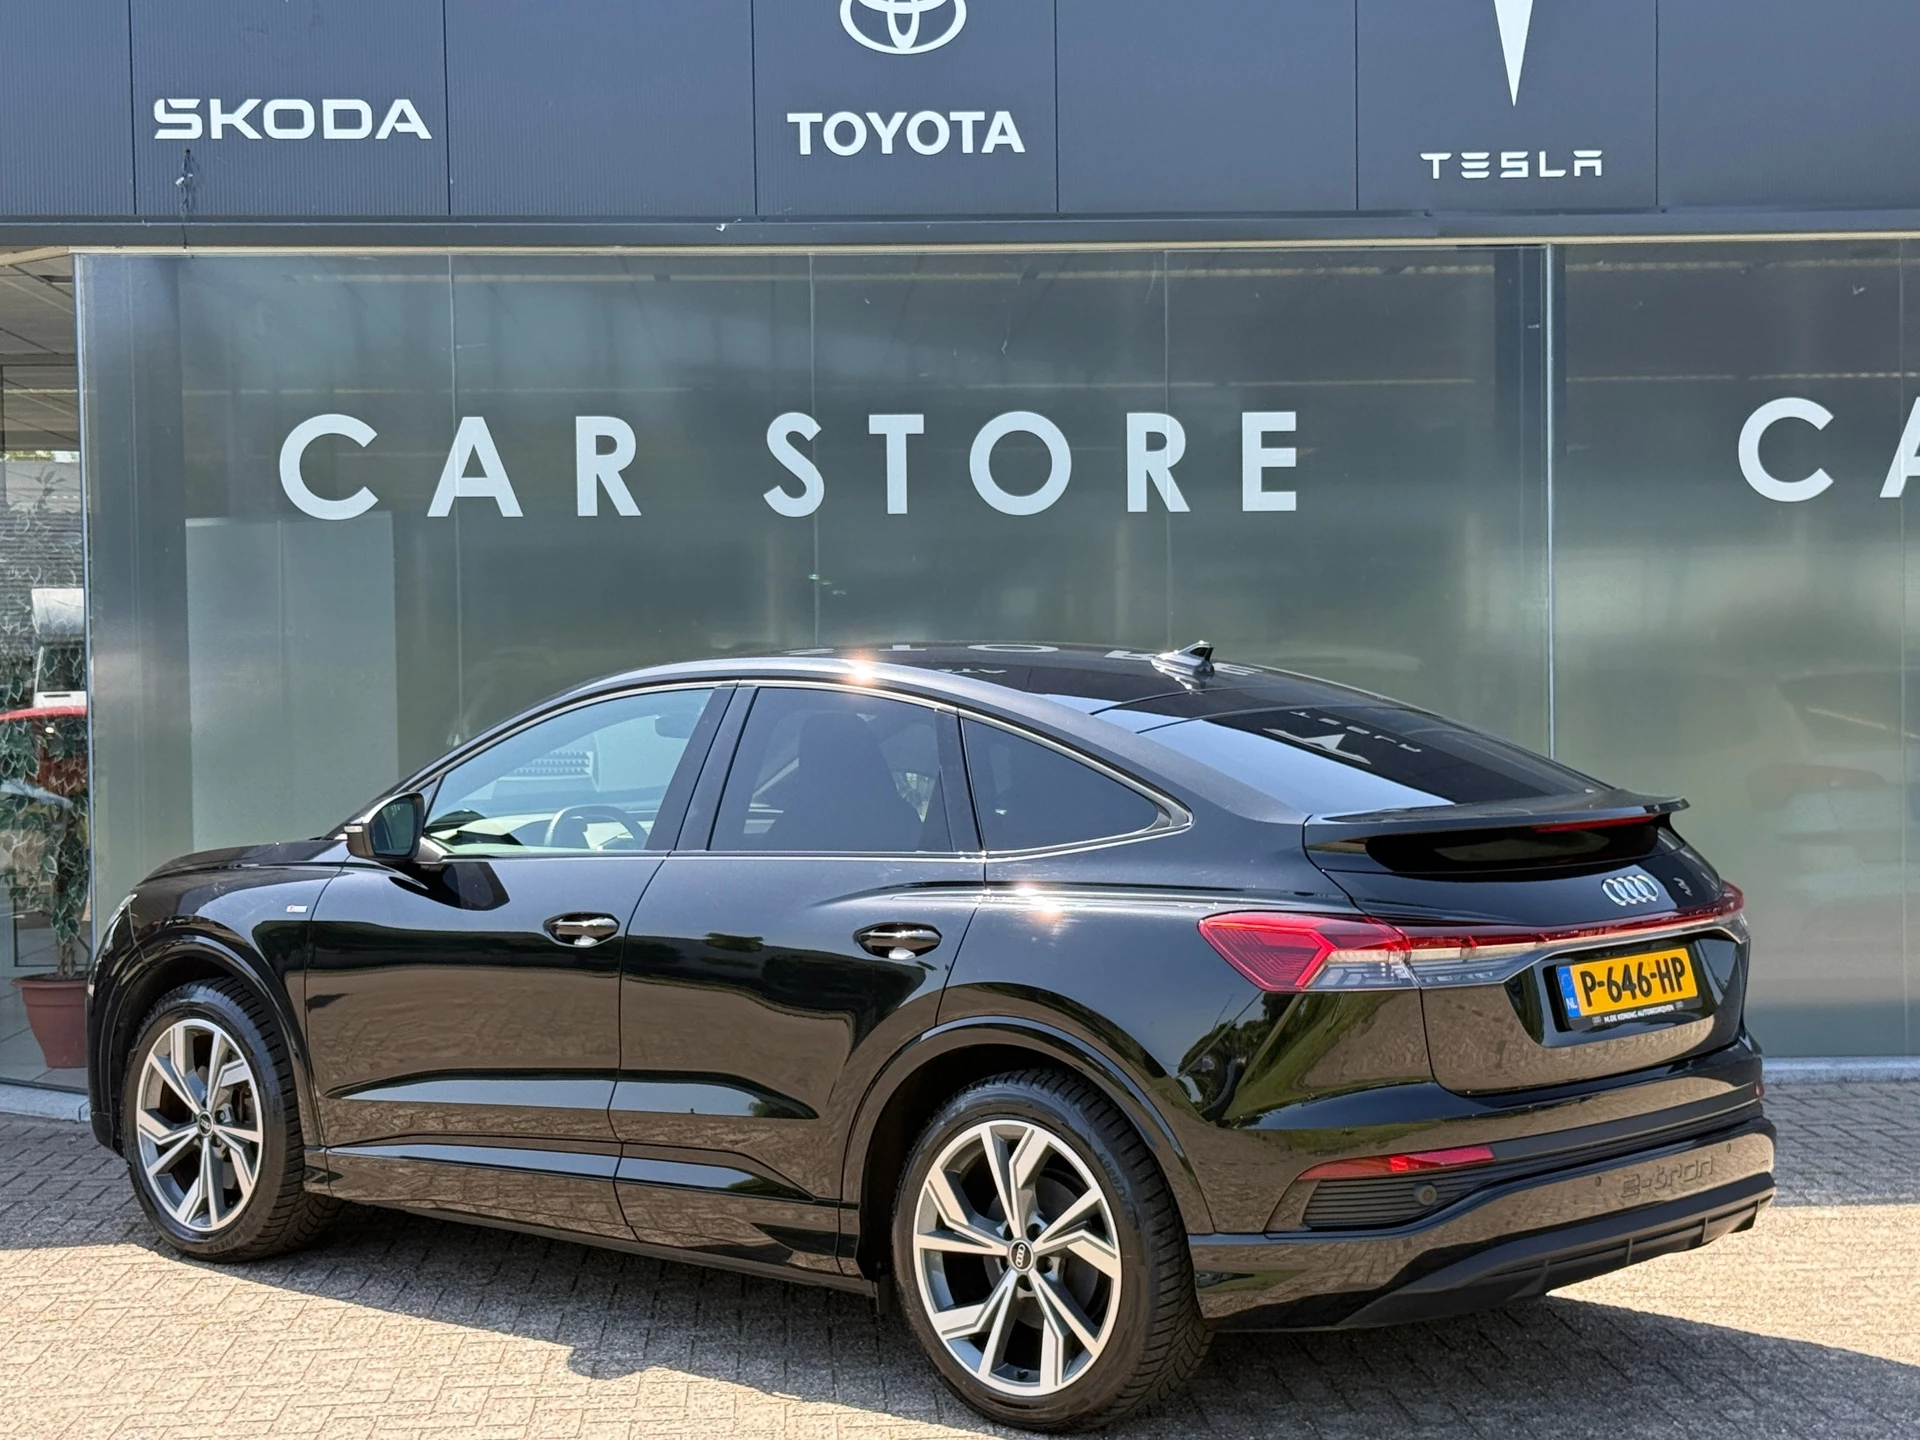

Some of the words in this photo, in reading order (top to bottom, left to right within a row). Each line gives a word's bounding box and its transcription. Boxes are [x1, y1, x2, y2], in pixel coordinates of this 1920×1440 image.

[786, 110, 1026, 156] TOYOTA
[1420, 150, 1602, 179] TESLA
[279, 413, 642, 521] CAR
[763, 411, 1297, 517] STORE
[1565, 997, 1578, 1010] NL
[1579, 956, 1686, 1007] P-646-HP
